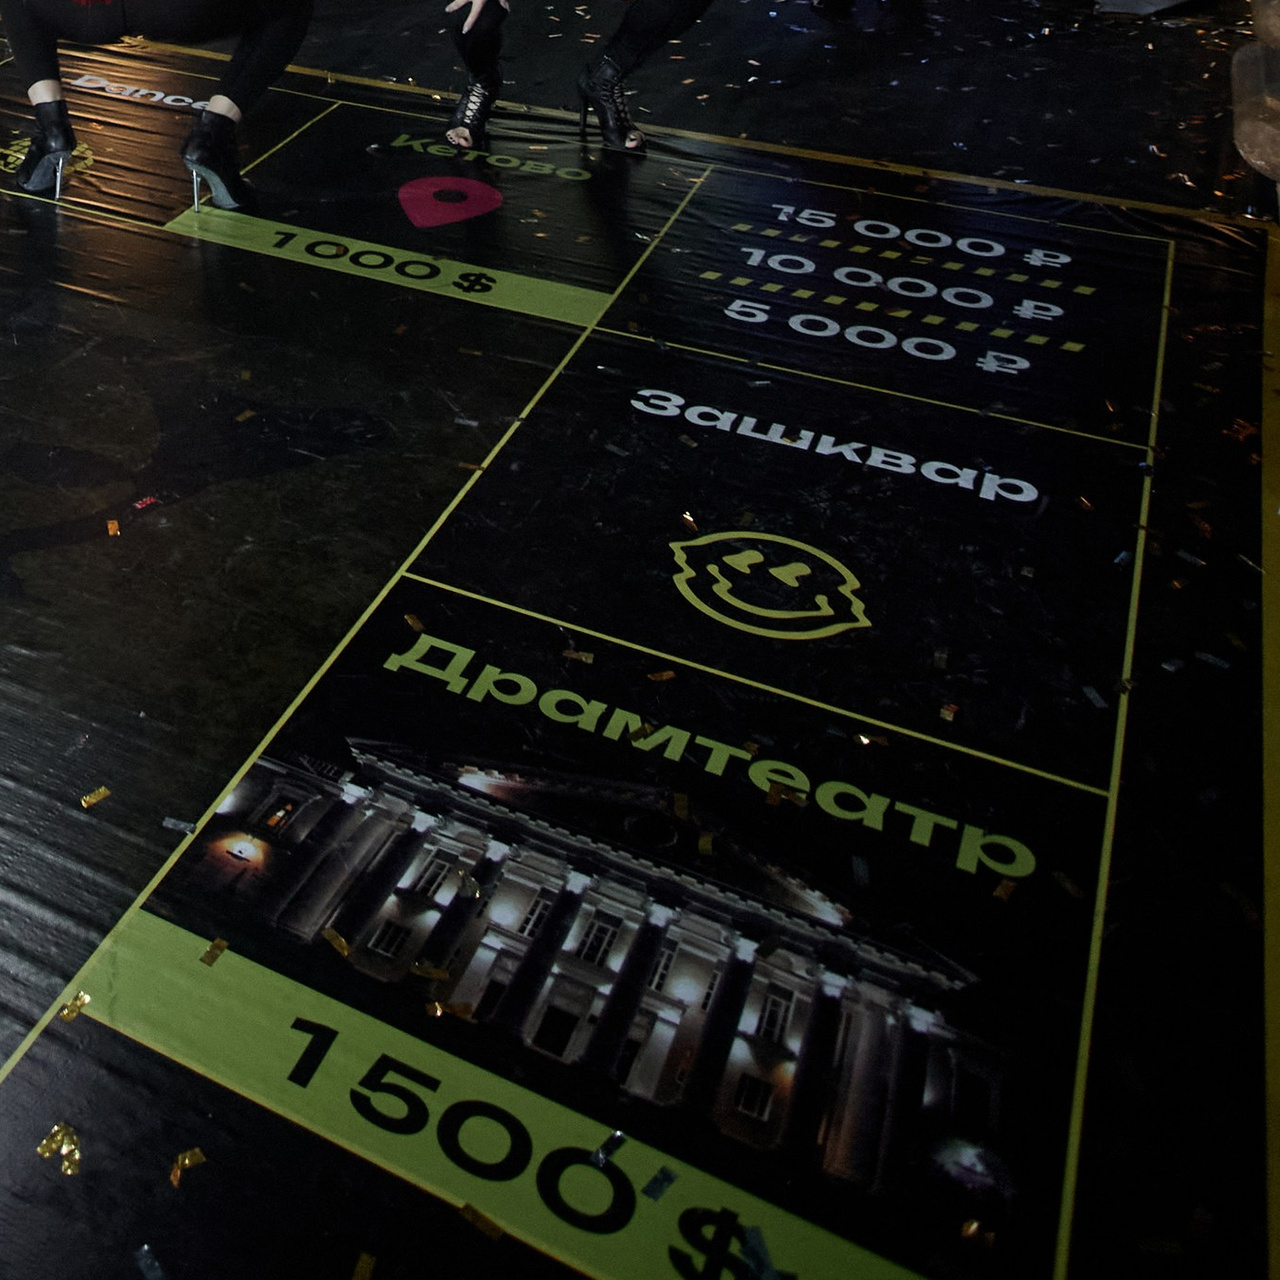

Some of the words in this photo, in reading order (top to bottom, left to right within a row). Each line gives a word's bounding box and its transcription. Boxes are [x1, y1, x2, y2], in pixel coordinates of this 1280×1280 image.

[390, 132, 592, 181] Кетово
[272, 229, 442, 280] 1000
[452, 271, 498, 294] $
[770, 203, 837, 228] 15
[853, 219, 1007, 259] 000
[1021, 248, 1073, 268] ₽
[738, 247, 816, 276] 10
[833, 265, 994, 311] 000
[1013, 299, 1065, 321] ₽
[723, 299, 771, 324] 5
[788, 314, 957, 362] 000
[976, 350, 1032, 375] ₽
[629, 388, 1040, 504] Зашквар
[384, 631, 1038, 882] Драмтеатр
[285, 1016, 637, 1235] 1500
[669, 1206, 799, 1280] $
